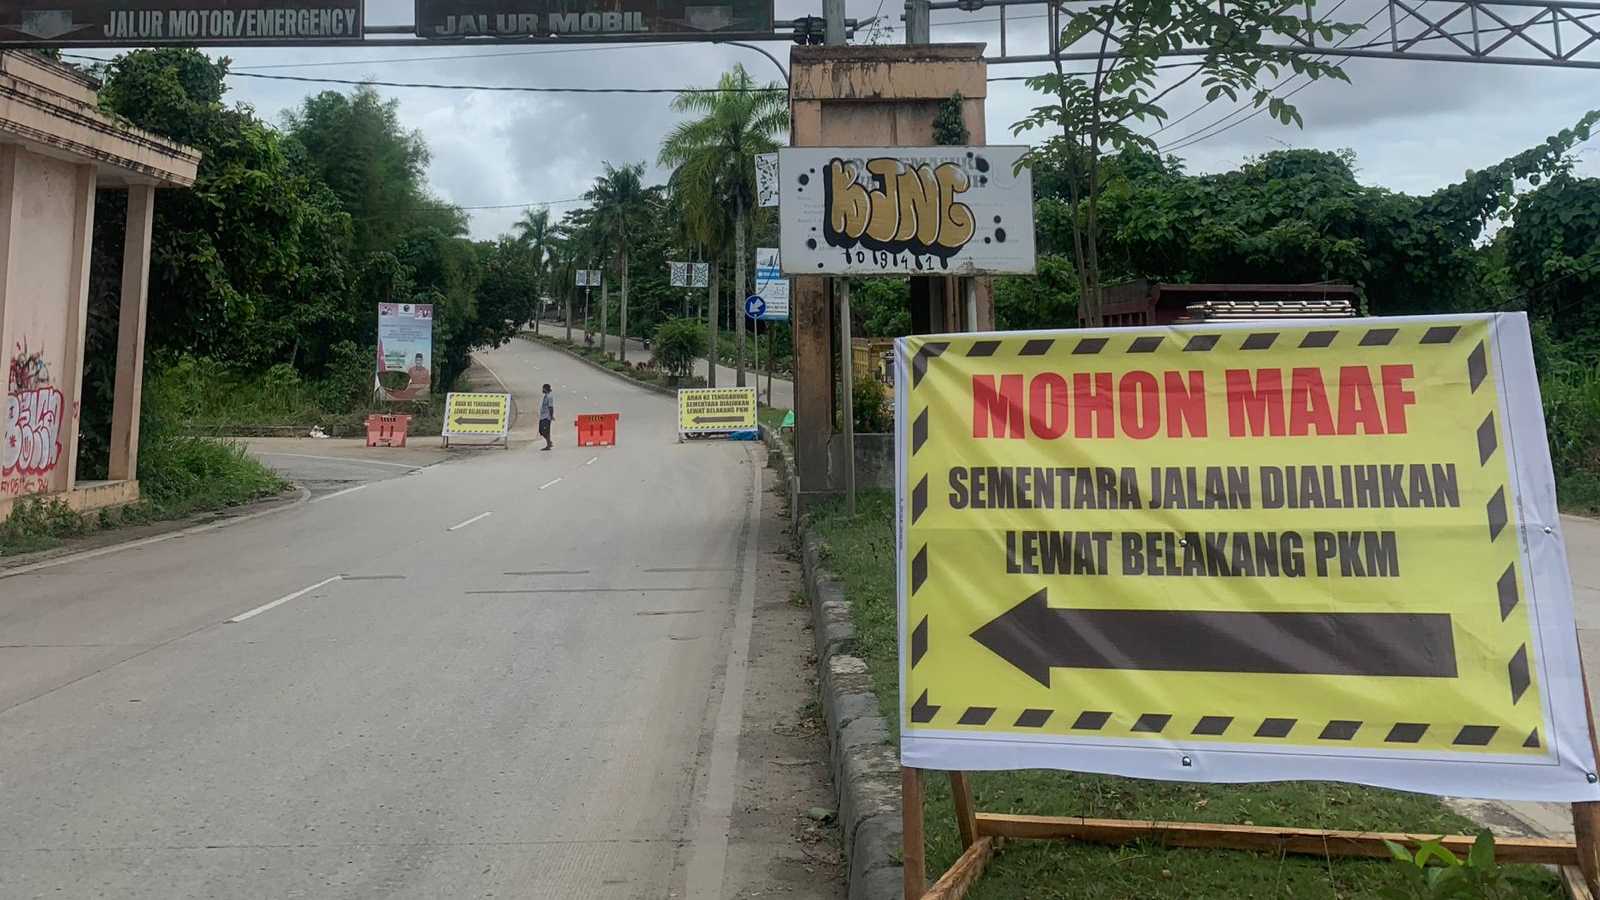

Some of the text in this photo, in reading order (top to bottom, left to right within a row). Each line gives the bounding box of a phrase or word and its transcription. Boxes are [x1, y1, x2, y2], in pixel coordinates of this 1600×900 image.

[104, 9, 356, 38] JALUR MOTOR/EMERGENCY
[435, 11, 649, 34] JALUR MOBIL
[971, 365, 1415, 440] MOHON MAAF
[948, 463, 1461, 510] SEMENTARA JALAN DIALIHKAN
[1005, 530, 1401, 578] LEWAT BELAKANG PKM
